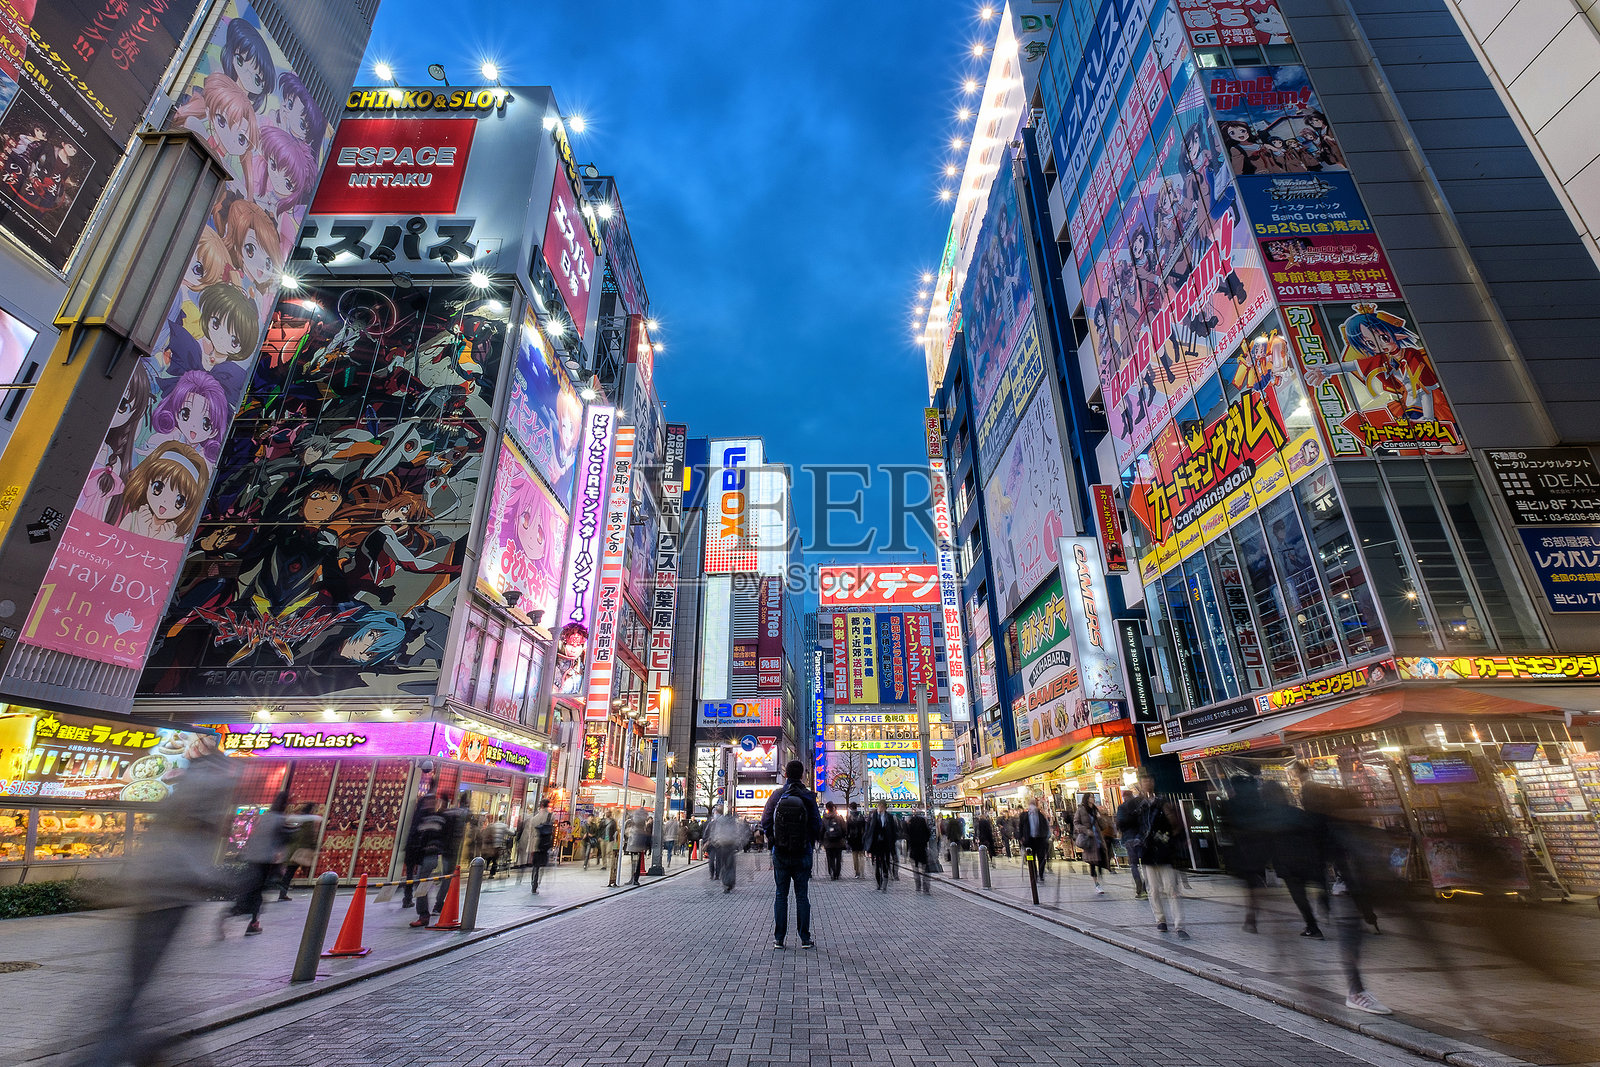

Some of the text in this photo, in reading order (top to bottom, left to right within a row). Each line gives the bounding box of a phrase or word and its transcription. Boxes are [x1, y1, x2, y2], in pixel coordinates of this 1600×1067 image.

[1194, 32, 1217, 44] 6F
[1221, 27, 1256, 37] 秋葉原
[1223, 36, 1258, 44] 2号店
[336, 145, 458, 174] ESPACE
[348, 171, 433, 190] NITTAKU
[1269, 202, 1341, 212] ブースターパック
[1271, 211, 1347, 222] BanG Dream!
[1272, 268, 1388, 285] 事前登録受付中!
[1277, 281, 1392, 296] 2017年春 配信予定!
[675, 427, 686, 463] HOBBY
[1360, 421, 1458, 447] カードキングダム
[664, 427, 677, 479] PARADISE
[1146, 389, 1288, 544] カードキングダム
[1489, 451, 1528, 460] 不動産の
[1494, 458, 1592, 470] トータルコンサルタント
[933, 476, 950, 537] TAKARADA
[1550, 499, 1569, 510] 8F
[110, 573, 160, 606] BOX
[822, 568, 938, 600] オノデン
[1073, 543, 1104, 650] GAMERS
[65, 591, 93, 617] In
[55, 616, 139, 656] Stores
[596, 586, 616, 662] アキバ駅前店
[768, 611, 782, 638] Free
[835, 642, 846, 665] TAX
[945, 608, 964, 678] 歓迎光臨
[814, 651, 823, 694] Panasonic
[836, 667, 848, 699] FREE
[1031, 652, 1072, 688] AKIHABARA
[1127, 626, 1149, 716] ALIENWARE STORE AKIBA
[1029, 669, 1080, 711] GAMERS
[1283, 669, 1367, 706] カードキングダム
[840, 715, 857, 723] TAX
[860, 715, 883, 723] FREE
[1187, 705, 1249, 726] ALIENWARE STORE AKIBA
[57, 724, 161, 749] 銀座ライオン
